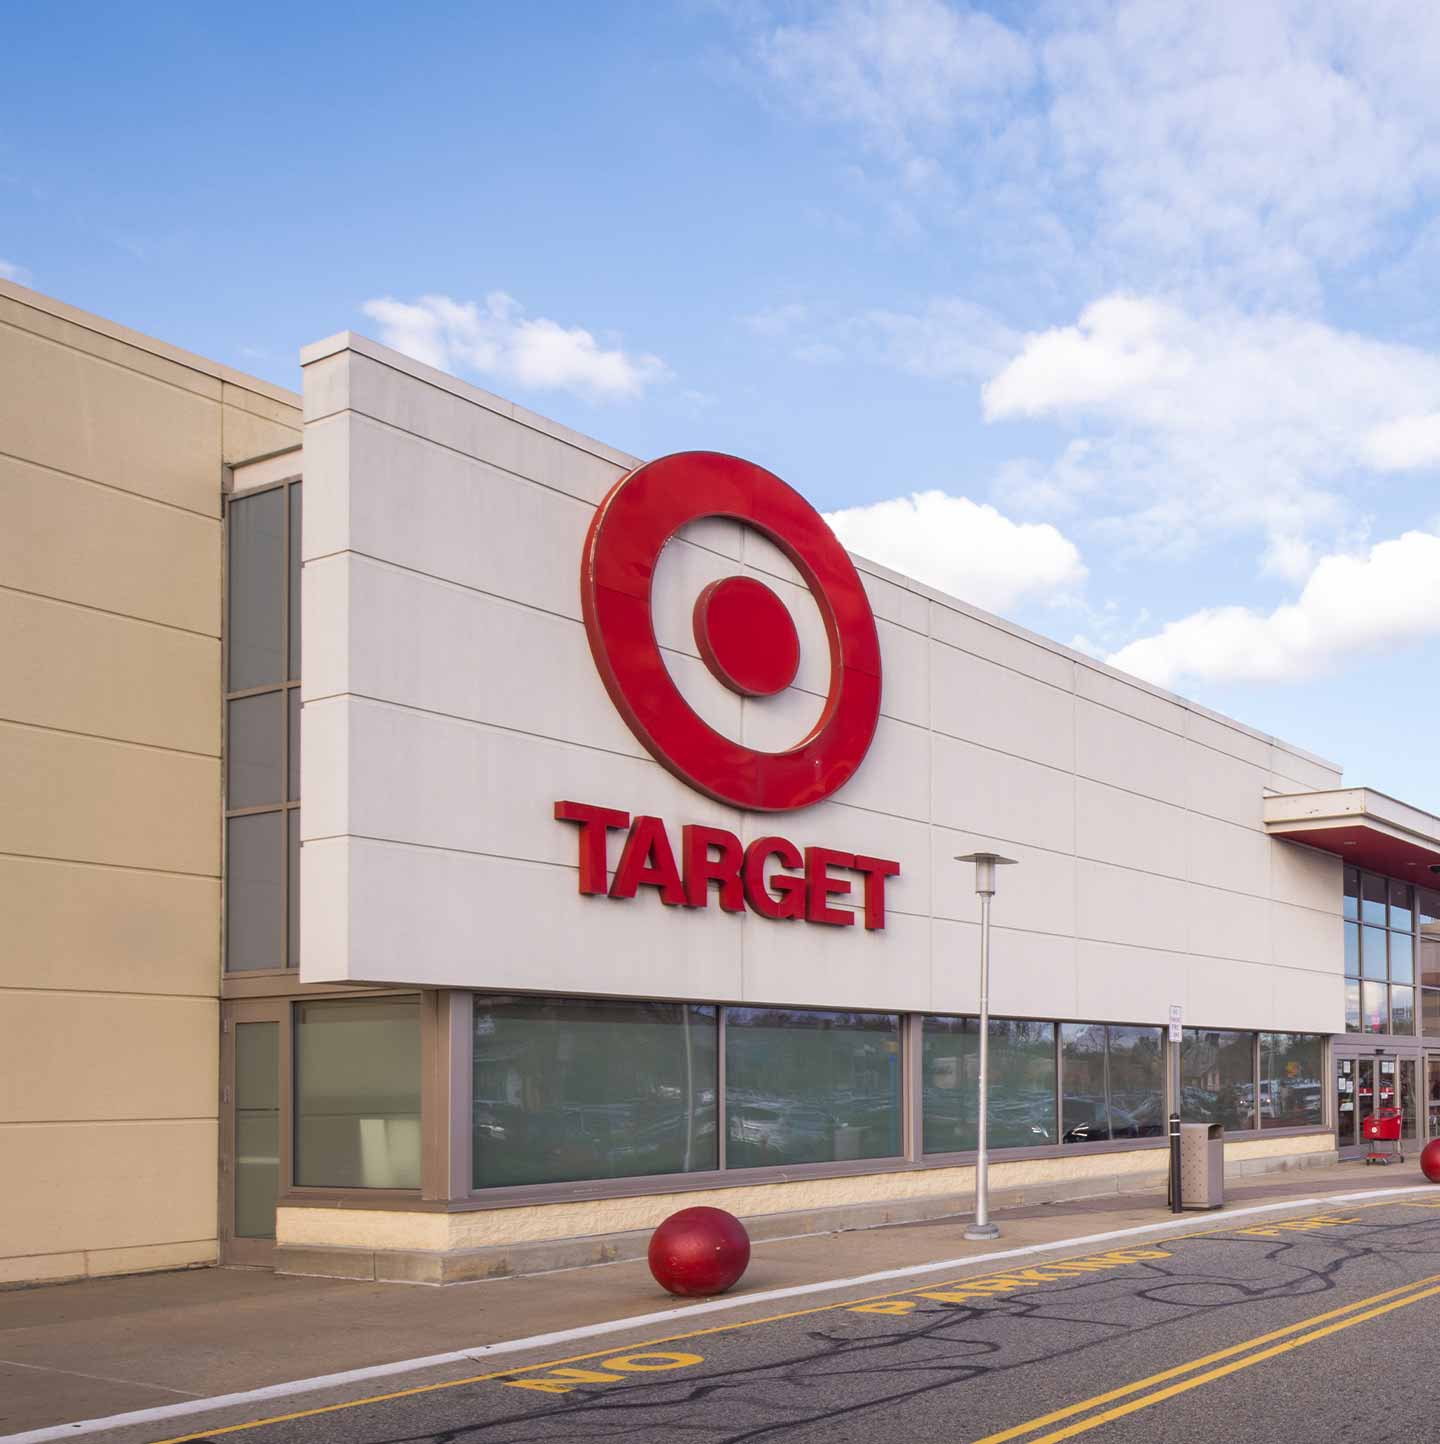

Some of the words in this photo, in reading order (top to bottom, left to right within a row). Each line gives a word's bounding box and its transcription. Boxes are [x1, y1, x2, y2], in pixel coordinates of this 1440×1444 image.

[554, 800, 900, 930] TARGET
[502, 1351, 705, 1393] NO
[849, 1250, 1173, 1315] PARKING
